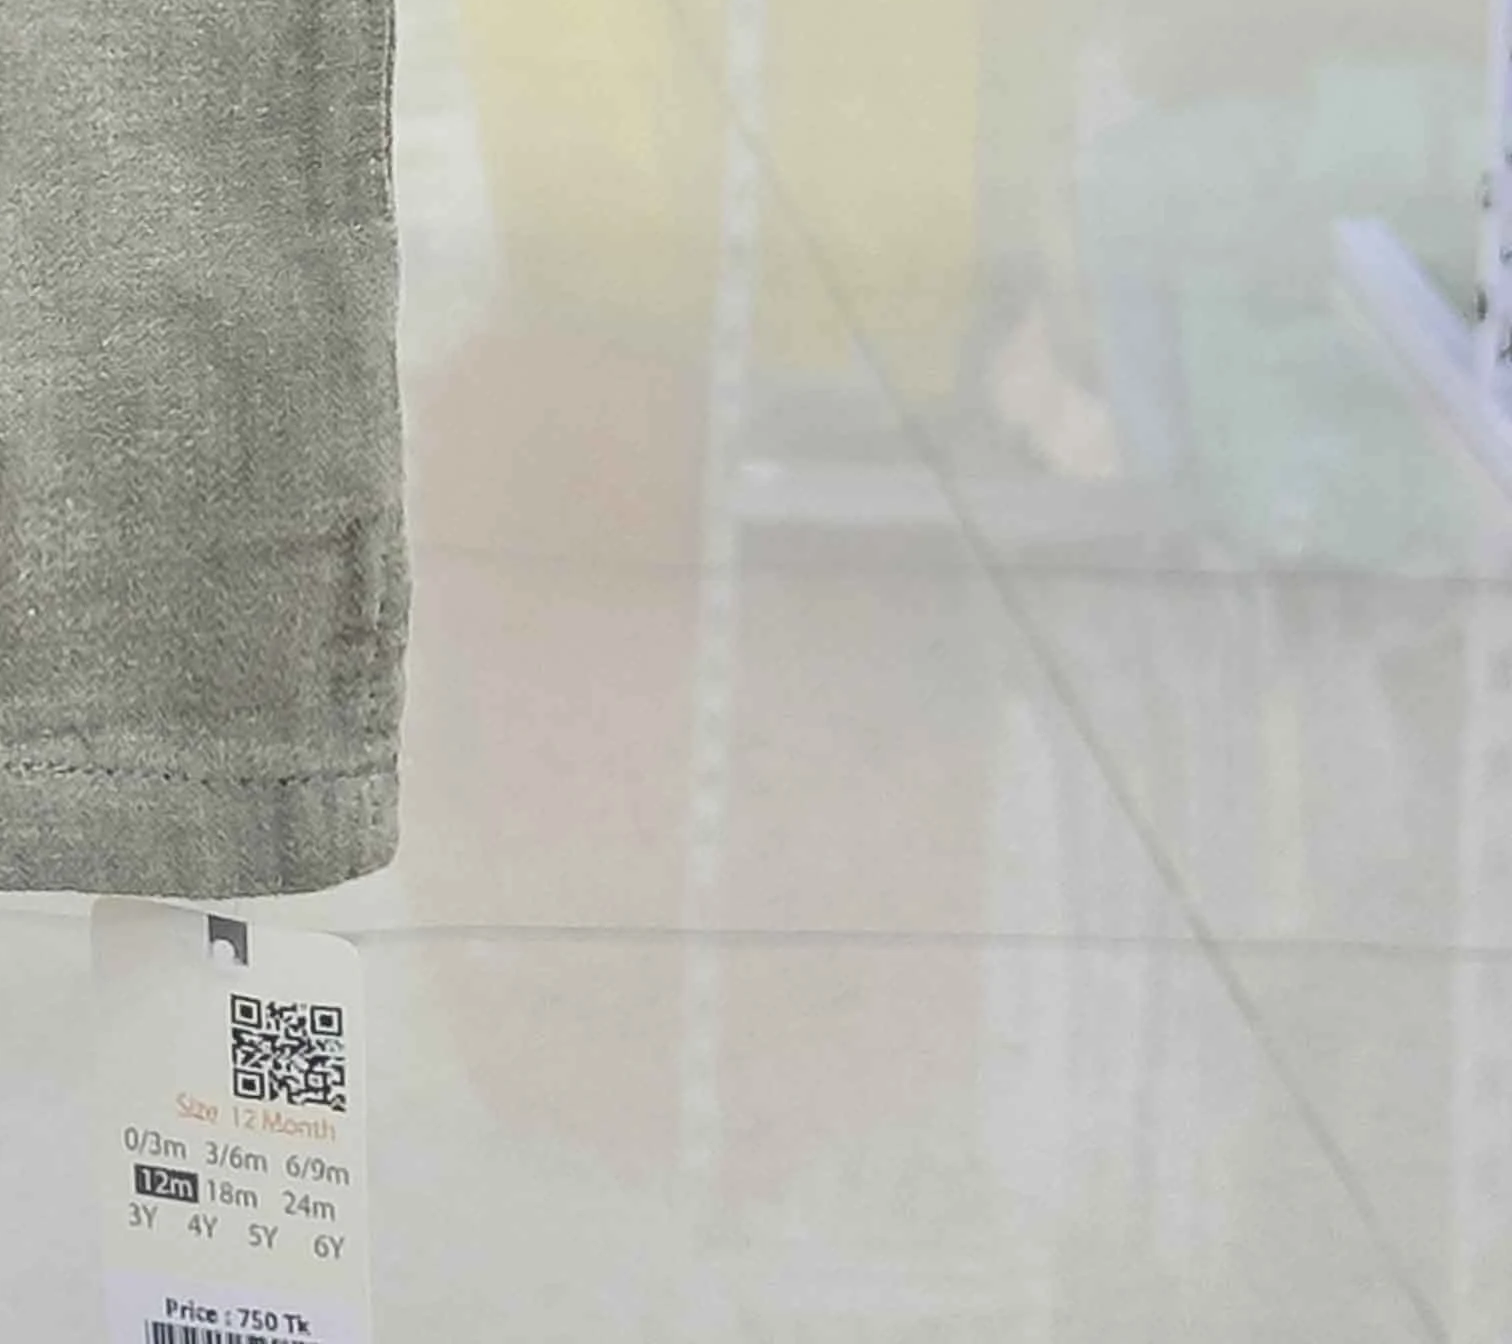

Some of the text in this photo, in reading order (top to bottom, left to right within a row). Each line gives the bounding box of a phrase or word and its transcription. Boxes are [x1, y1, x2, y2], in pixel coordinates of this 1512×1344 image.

[233, 1106, 257, 1130] 12
[262, 1109, 337, 1141] Month
[124, 1127, 350, 1186] 0/3m 3/6m 6/9m
[141, 1168, 336, 1222] 12m 18m 24m
[128, 1202, 345, 1259] 3Y 4Y 5Y 6Y
[165, 1297, 218, 1324] Price
[237, 1308, 278, 1331] 750
[283, 1314, 311, 1335] Tk
